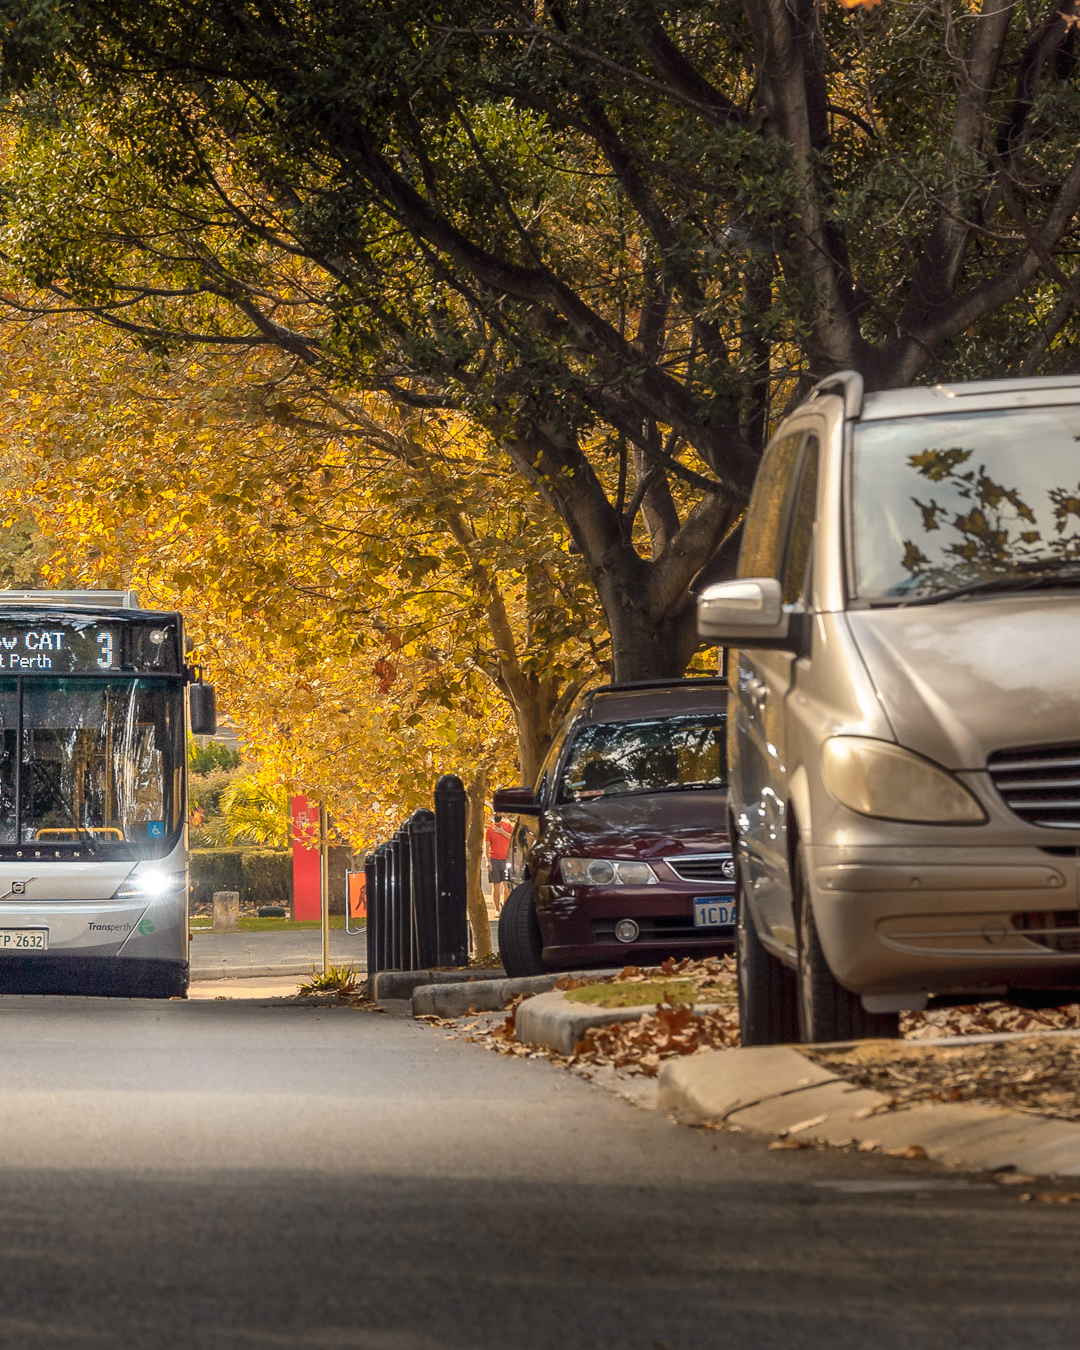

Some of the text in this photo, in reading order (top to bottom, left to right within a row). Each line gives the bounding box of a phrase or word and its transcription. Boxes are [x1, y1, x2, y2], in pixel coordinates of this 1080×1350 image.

[25, 631, 65, 650] CAT
[96, 631, 113, 669] 3
[9, 653, 52, 668] Perth
[88, 922, 131, 933] Transperth
